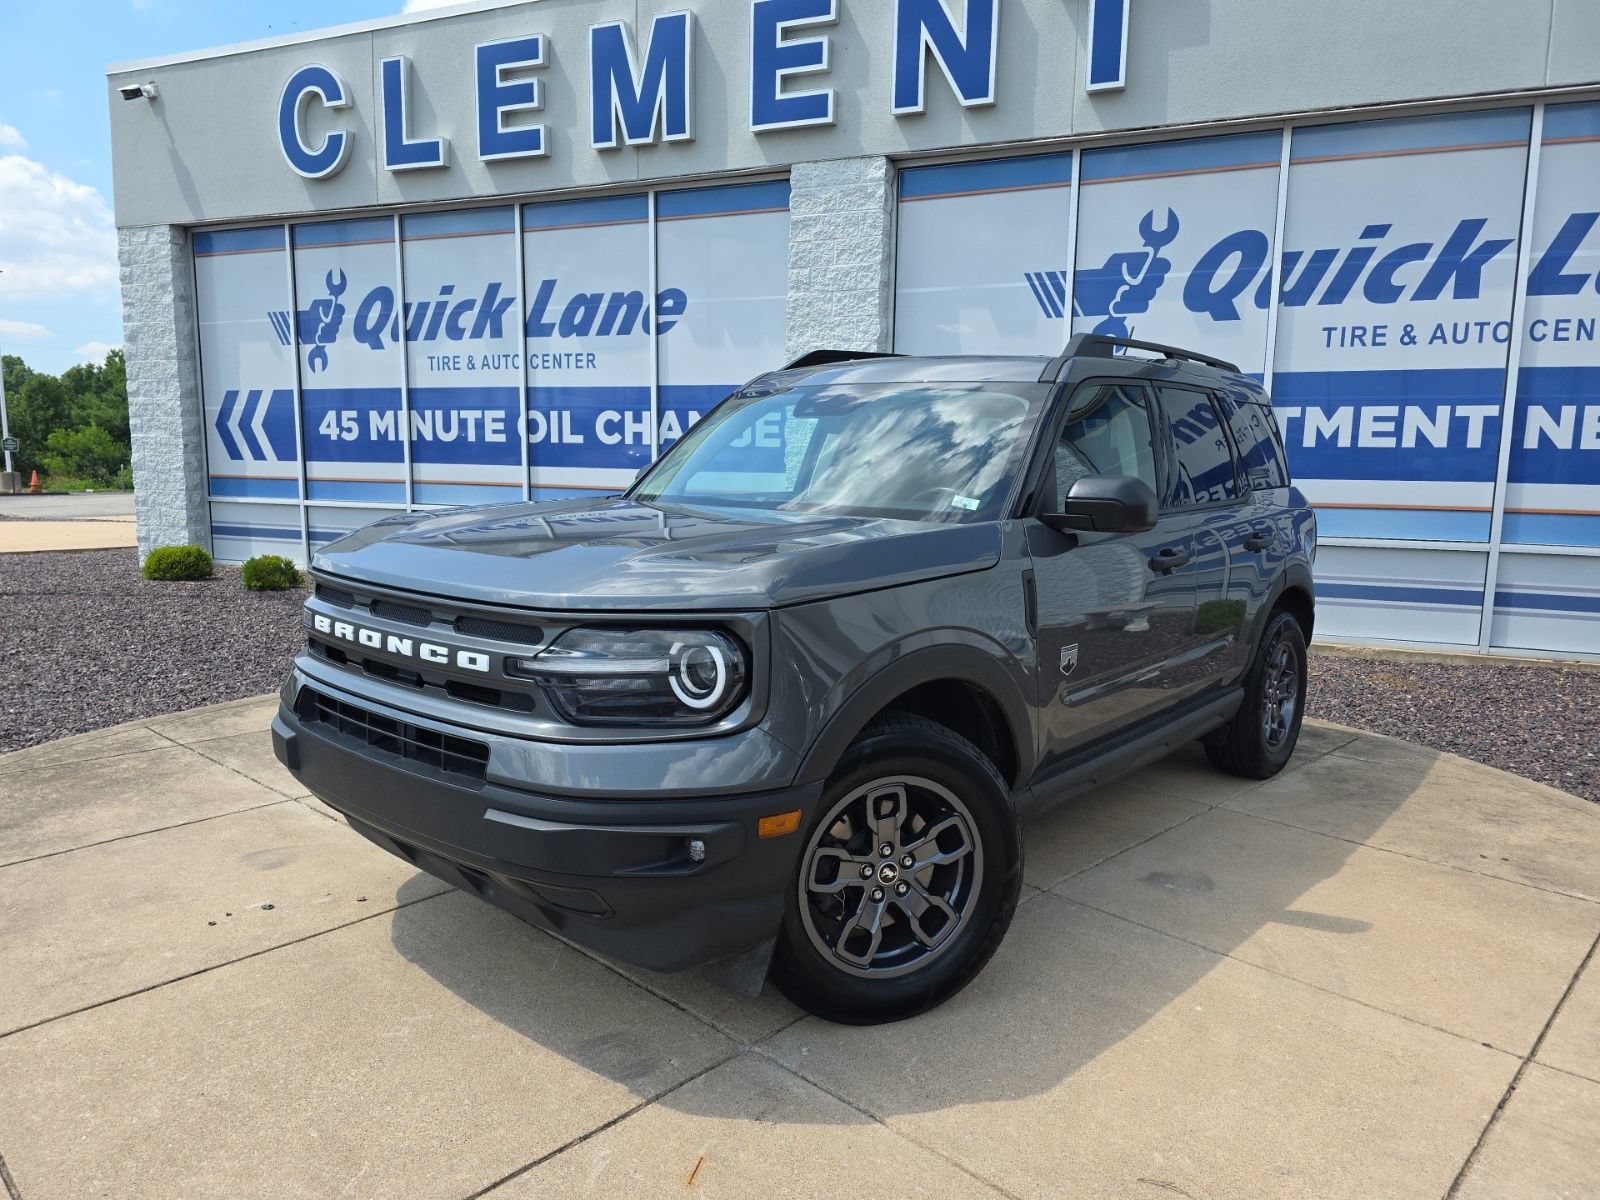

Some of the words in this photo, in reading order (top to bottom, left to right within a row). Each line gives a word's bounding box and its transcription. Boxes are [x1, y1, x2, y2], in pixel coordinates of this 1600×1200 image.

[1182, 218, 1516, 321] Quick
[1526, 212, 1600, 296] L
[353, 282, 516, 350] Quick
[525, 279, 687, 338] Lane
[1322, 324, 1388, 348] TIRE
[1399, 324, 1418, 346] &
[1428, 320, 1511, 345] AUTO
[428, 355, 461, 371] TIRE
[466, 354, 476, 370] &
[481, 353, 519, 370] AUTO
[530, 353, 596, 369] CENTER
[318, 410, 359, 441] 45
[369, 409, 507, 442] MINUTE
[517, 410, 583, 444] OIL
[595, 410, 781, 448] CHAE
[314, 614, 490, 672] BRONCO
